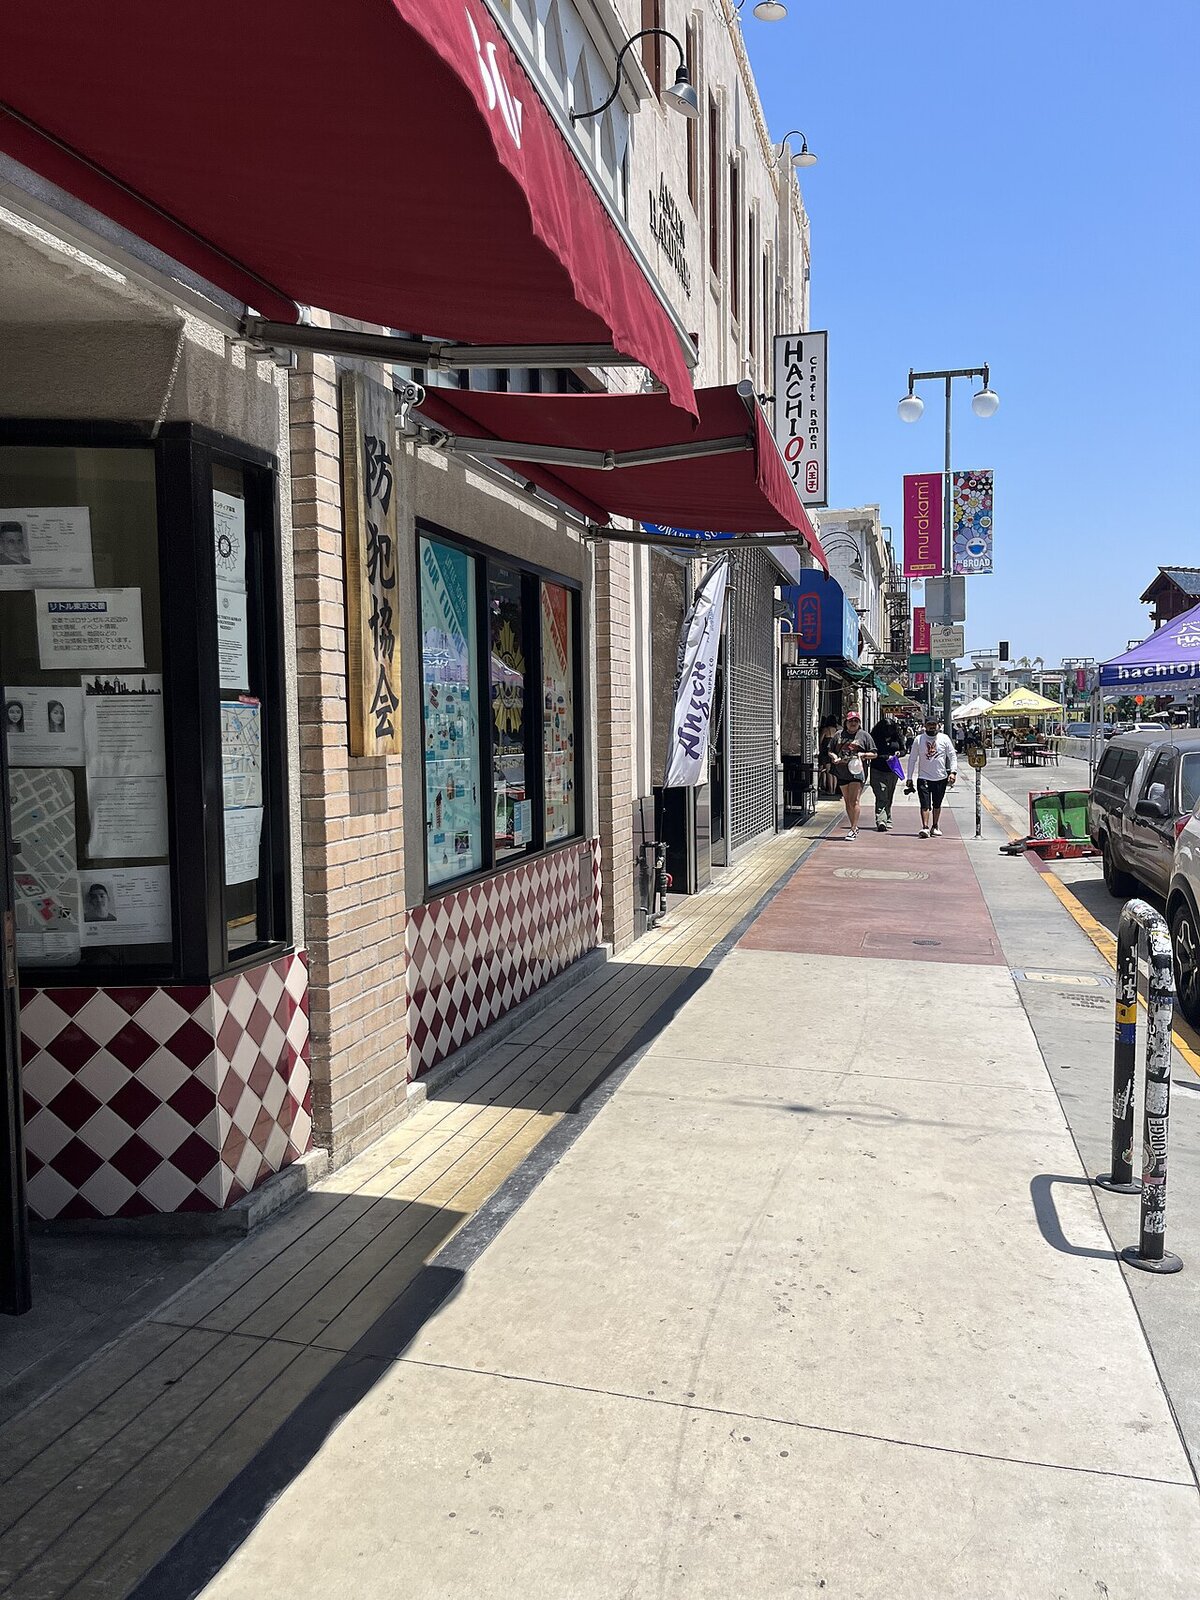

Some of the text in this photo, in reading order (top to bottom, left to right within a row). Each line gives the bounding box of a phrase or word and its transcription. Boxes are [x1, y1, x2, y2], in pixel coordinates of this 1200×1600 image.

[784, 339, 804, 486] HACHIOJ
[808, 356, 819, 450] Craft Ramen
[807, 463, 817, 489] 八王子
[913, 481, 930, 560] murakami
[364, 434, 400, 740] 防犯協会
[423, 545, 440, 590] OUR
[963, 558, 991, 567] BROAD
[801, 600, 817, 642] 八王子
